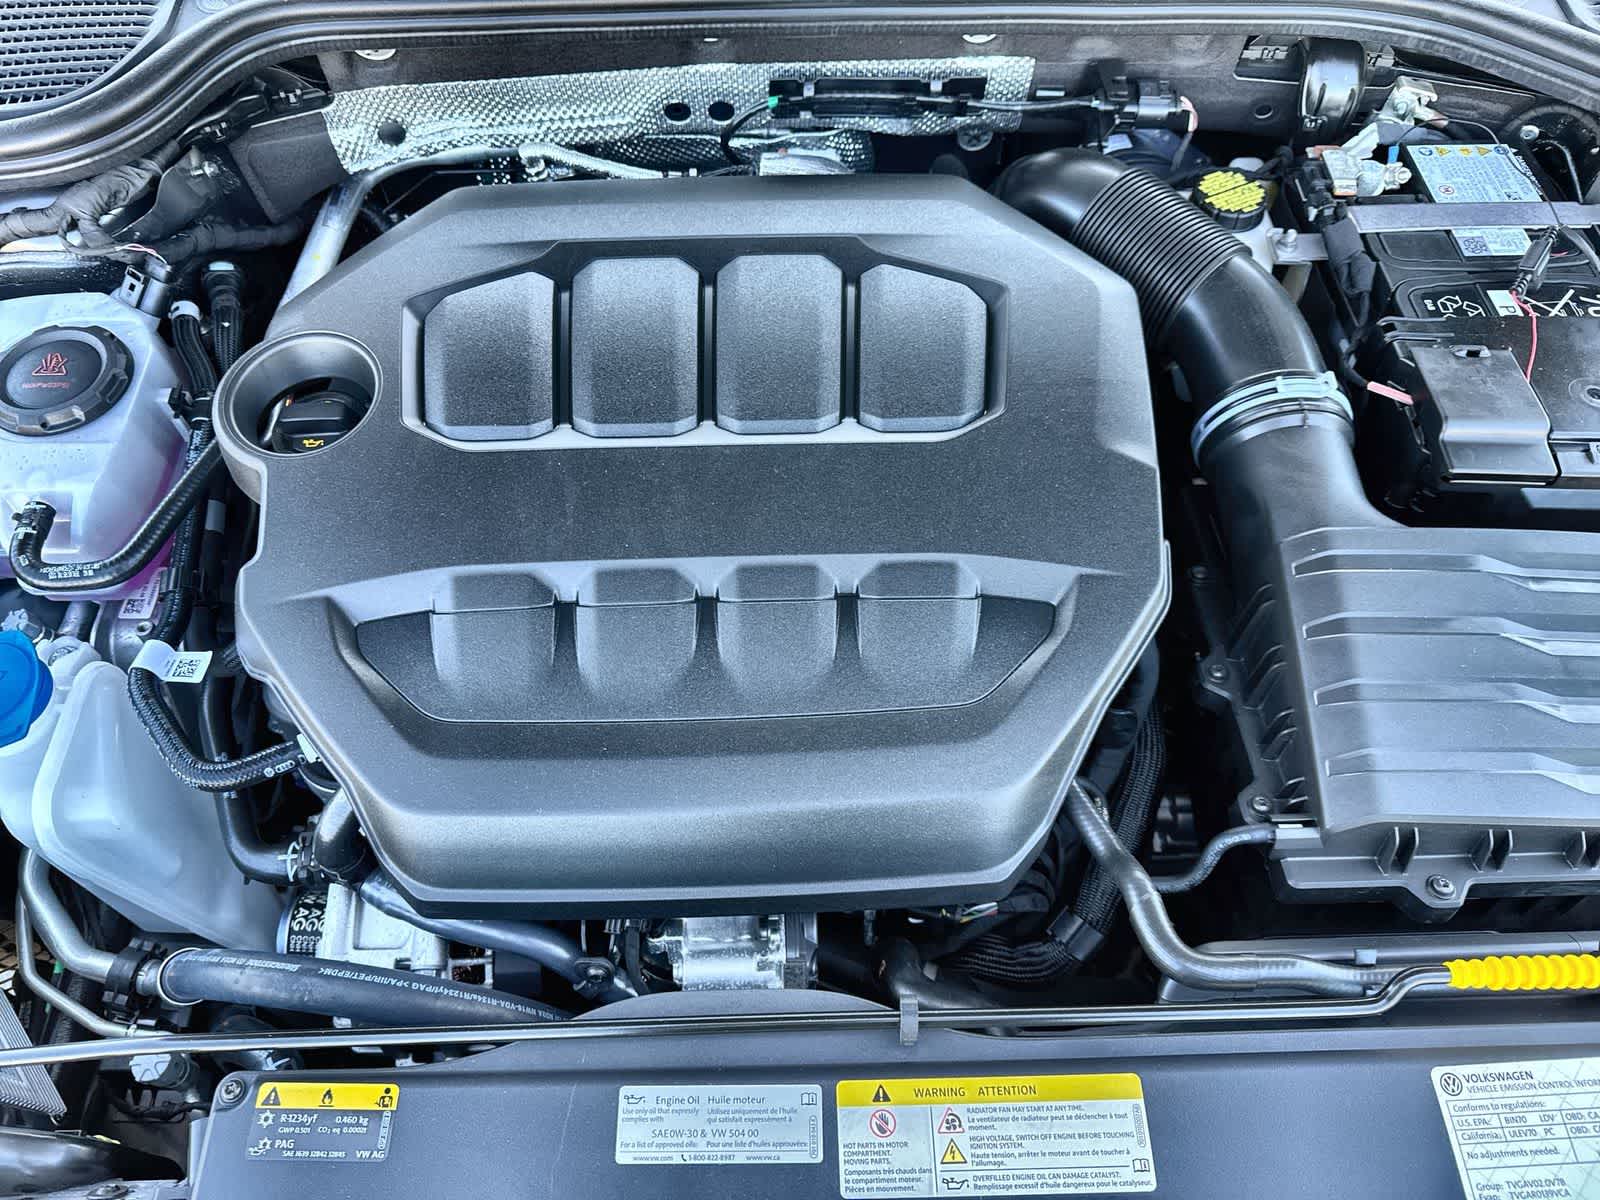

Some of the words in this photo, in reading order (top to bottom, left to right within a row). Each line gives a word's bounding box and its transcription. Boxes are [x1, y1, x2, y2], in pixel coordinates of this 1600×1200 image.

[1462, 1070, 1535, 1084] VOLKSWAGEN
[977, 1084, 1038, 1097] ATTENTION
[1466, 1084, 1499, 1094] VEHICLE
[1499, 1082, 1538, 1092] EMISSION
[1537, 1080, 1575, 1090] CONTROL
[913, 1087, 967, 1099] WARNING
[655, 1095, 686, 1108] Engine
[687, 1095, 700, 1105] Oil
[707, 1095, 732, 1105] Huile
[733, 1095, 767, 1105] moteur
[966, 1106, 998, 1114] RADIATOR
[1011, 1105, 1025, 1113] MAY
[1026, 1105, 1045, 1113] START
[1053, 1104, 1067, 1112] ANY
[1067, 1104, 1085, 1112] TIME.
[1452, 1103, 1490, 1113] Conforms
[1491, 1103, 1500, 1112] to
[1500, 1099, 1546, 1111] regulations:
[335, 1115, 358, 1124] 0.460
[359, 1115, 369, 1126] kg
[706, 1116, 718, 1125] qui
[976, 1115, 1011, 1123] ventilateur
[1020, 1114, 1049, 1122] radiateur
[1050, 1114, 1065, 1123] peut
[1074, 1112, 1108, 1121] déclencher
[1109, 1112, 1114, 1120] à
[1456, 1118, 1472, 1128] U.S.
[1473, 1117, 1491, 1127] EPA:
[1538, 1113, 1555, 1123] LDV
[278, 1126, 294, 1134] GWP
[700, 1128, 707, 1138] &
[711, 1128, 728, 1138] VW
[728, 1128, 746, 1138] 504
[747, 1128, 760, 1138] 00
[1508, 1127, 1538, 1139] ULEV70
[1543, 1126, 1556, 1137] PC
[1040, 1133, 1053, 1141] OFF
[1077, 1131, 1102, 1140] BEFORE
[1102, 1131, 1135, 1139] TOUCHING
[1460, 1130, 1503, 1141] California:
[274, 1139, 295, 1149] PAG
[655, 1141, 685, 1150] approved
[706, 1140, 721, 1148] Pour
[734, 1140, 747, 1148] liste
[747, 1140, 771, 1148] d'huiles
[842, 1142, 857, 1150] HOT
[877, 1141, 886, 1149] IN
[886, 1140, 909, 1149] MOTOR
[282, 1150, 295, 1158] SAE
[355, 1150, 370, 1159] VW
[370, 1150, 385, 1159] AG
[842, 1149, 893, 1158] COMPARTMENT.
[970, 1151, 990, 1159] Haute
[991, 1151, 1017, 1159] tension,
[1100, 1148, 1125, 1156] toucher
[1125, 1147, 1131, 1155] à
[1466, 1151, 1479, 1160] No
[1479, 1148, 1529, 1161] adjustments
[1529, 1146, 1561, 1156] needed.
[843, 1158, 870, 1166] MOVING
[870, 1157, 891, 1165] PARTS.
[971, 1159, 1007, 1168] l'allumage.
[844, 1168, 882, 1176] Composants
[882, 1167, 895, 1175] très
[895, 1167, 917, 1175] chauds
[972, 1174, 1011, 1182] OVERFILLED
[1012, 1173, 1036, 1181] ENGINE
[1036, 1173, 1047, 1181] OIL
[1047, 1172, 1062, 1180] CAN
[1062, 1171, 1089, 1179] DAMAGE
[1089, 1170, 1122, 1179] CATALYST.
[844, 1177, 851, 1185] le
[851, 1176, 898, 1185] compartiment
[898, 1175, 925, 1183] moteur.
[973, 1182, 1013, 1191] Remplissage
[1014, 1181, 1039, 1190] excessif
[1039, 1180, 1061, 1189] d'huile
[1062, 1180, 1095, 1189] dangereux
[1096, 1180, 1111, 1188] pour
[1111, 1179, 1118, 1187] le
[1118, 1179, 1153, 1188] catalyseur.
[844, 1185, 866, 1193] Pièces
[876, 1185, 917, 1193] mouvement.
[1475, 1182, 1504, 1193] Group:
